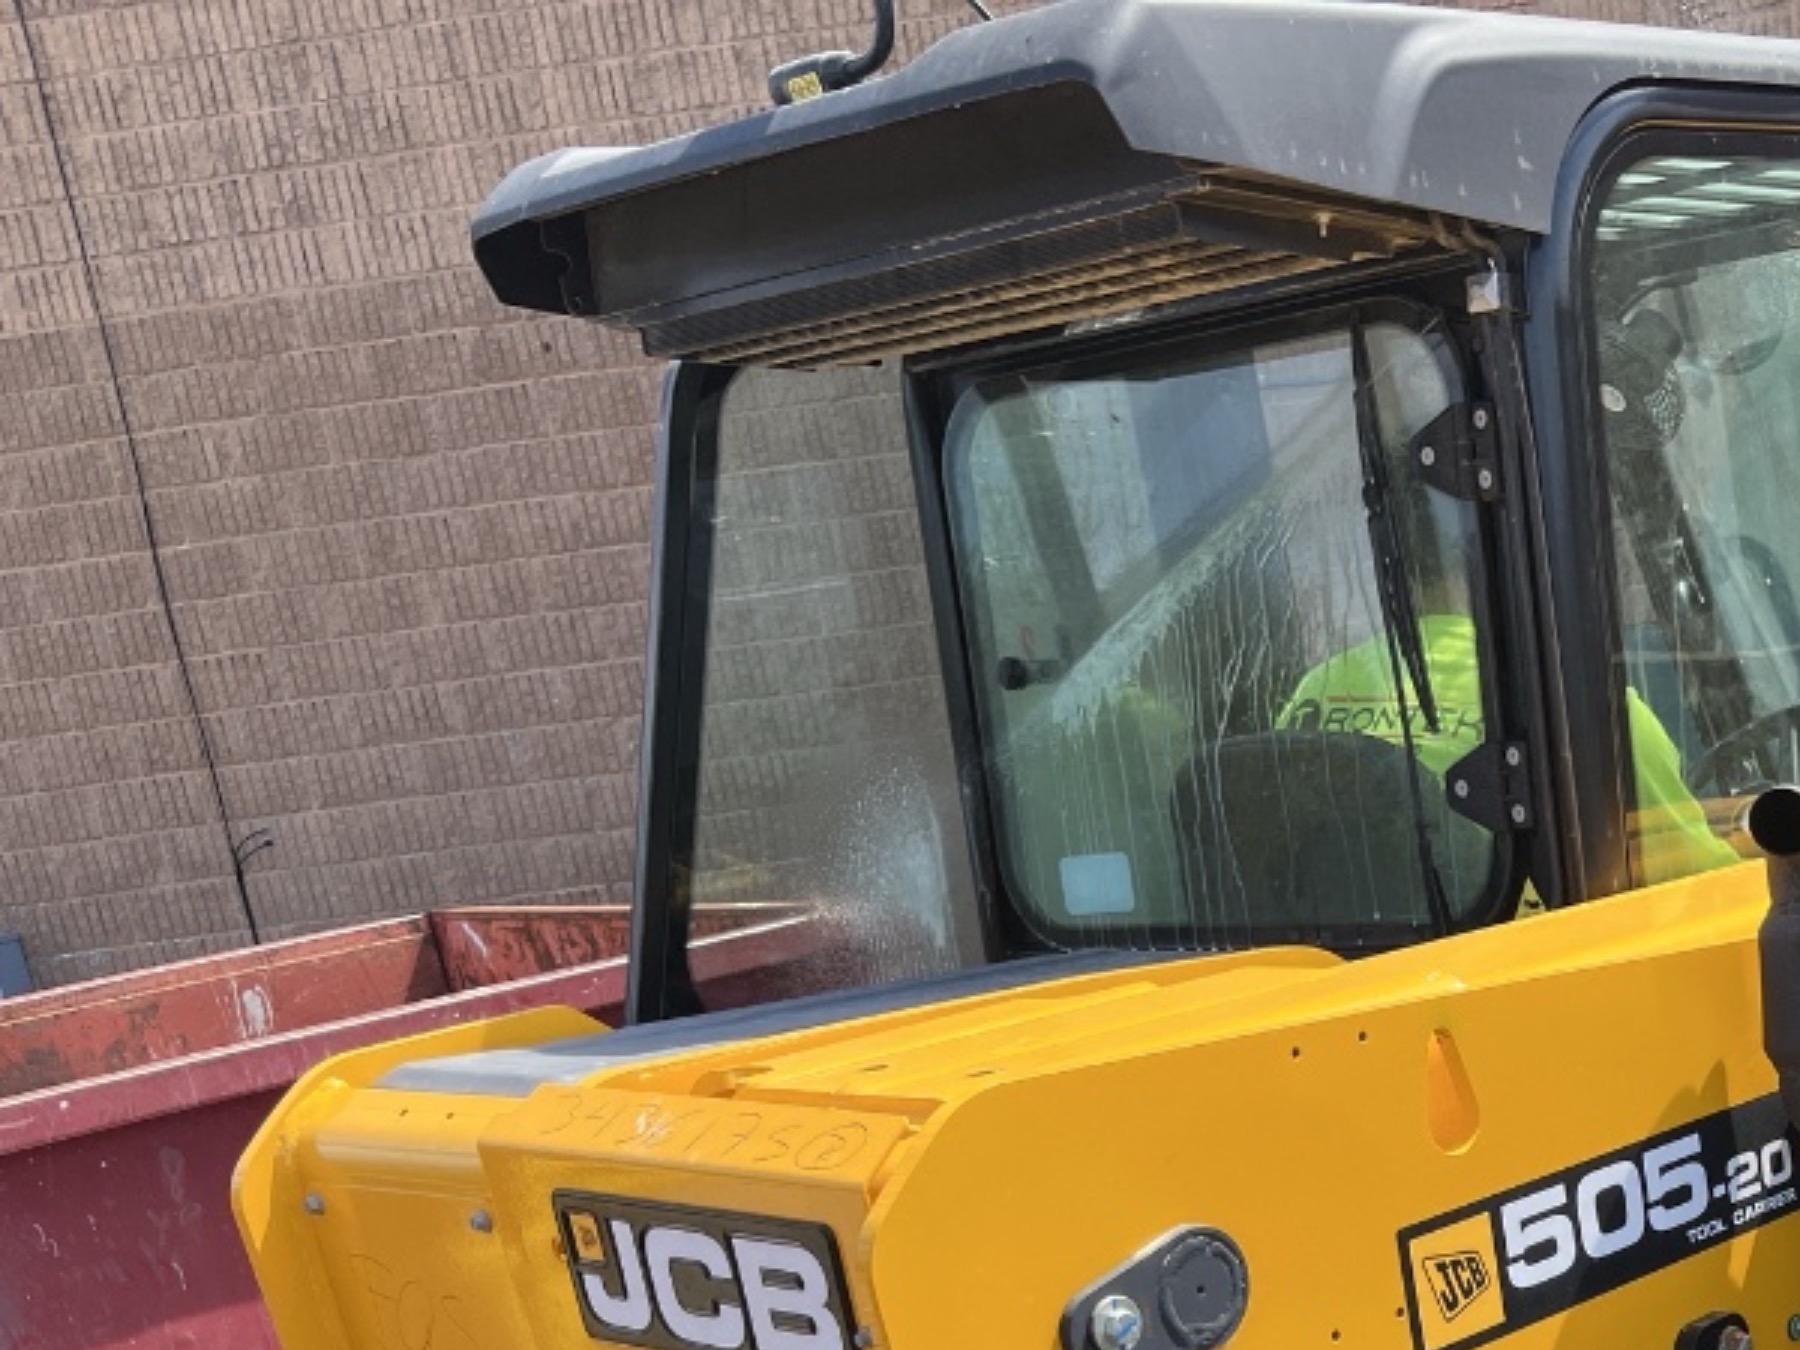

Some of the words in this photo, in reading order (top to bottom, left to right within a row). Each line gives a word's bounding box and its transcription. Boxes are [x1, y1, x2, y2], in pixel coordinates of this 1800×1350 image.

[1500, 1131, 1792, 1289] 505-20
[1686, 1219, 1729, 1244] TOOL
[1434, 1255, 1489, 1313] JCB
